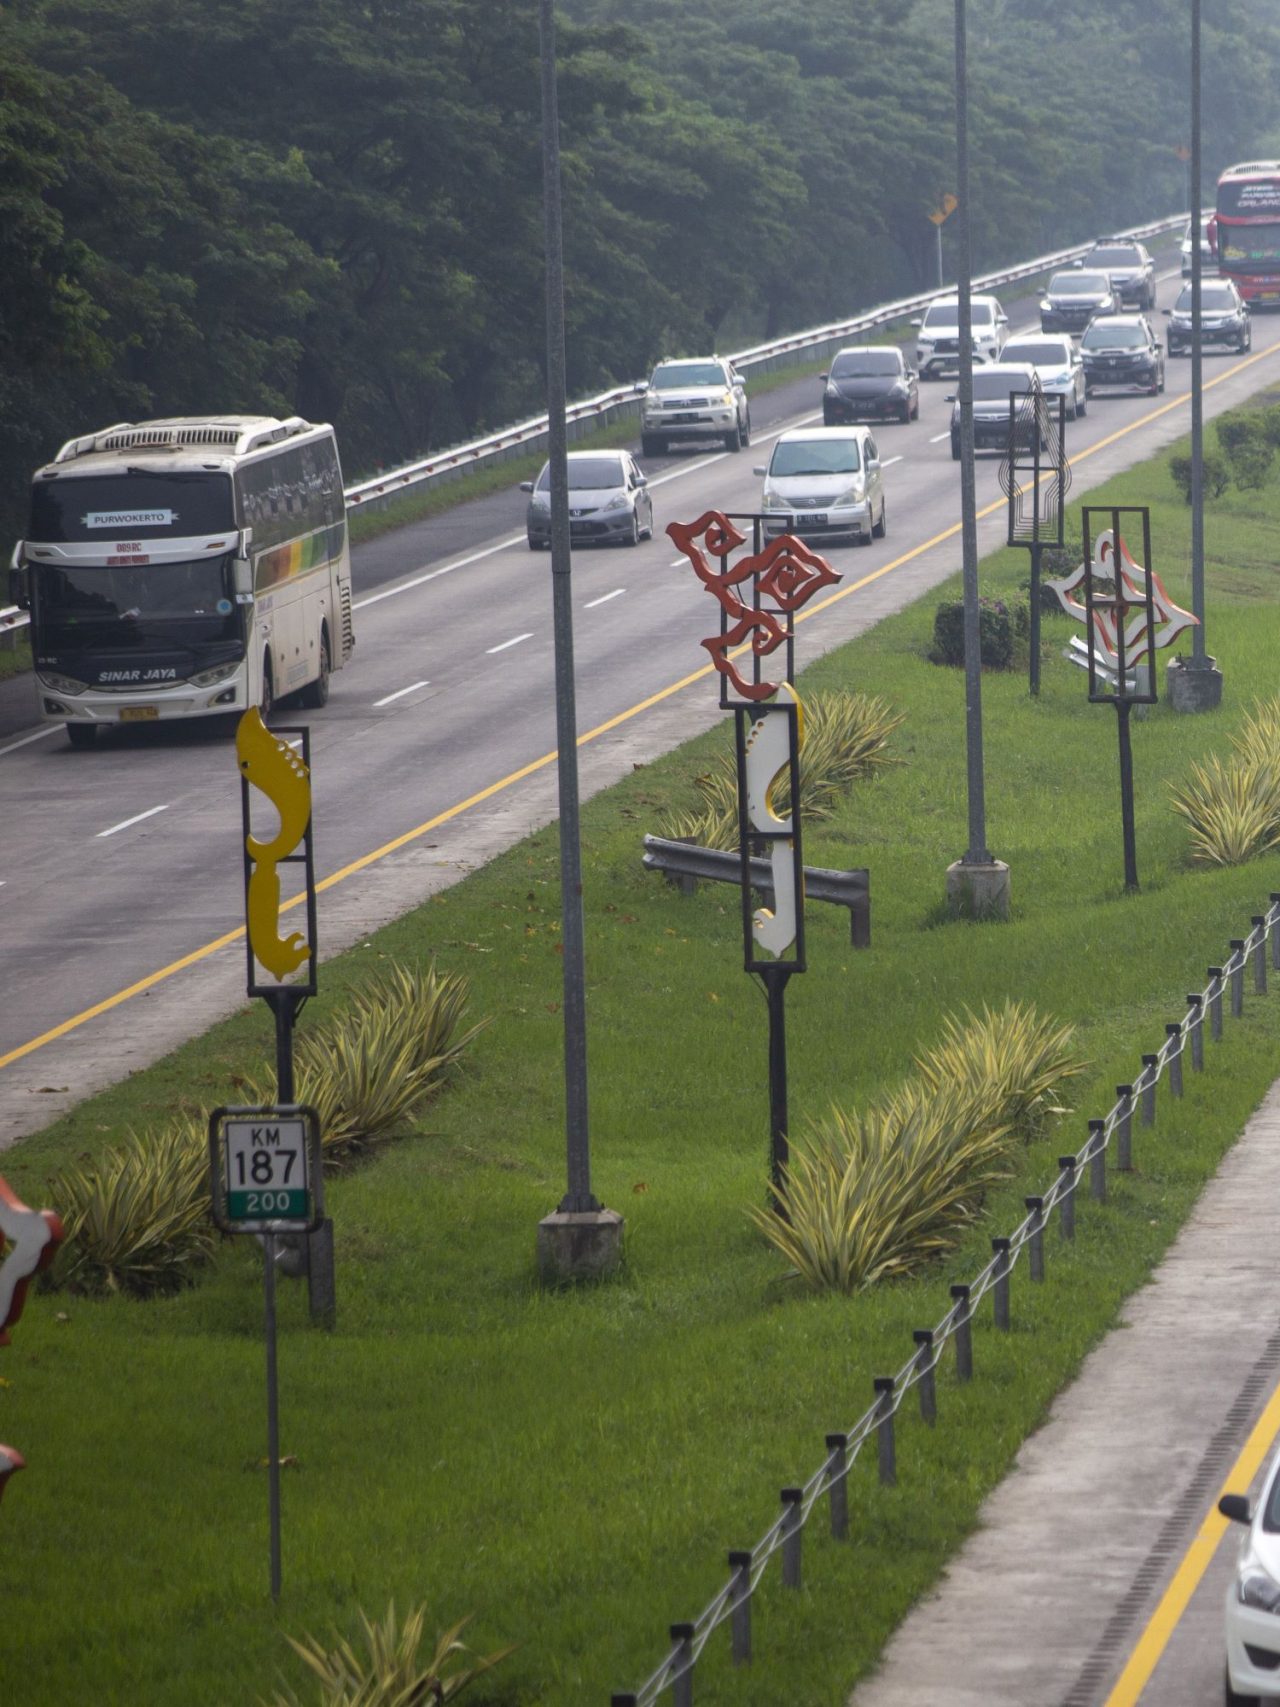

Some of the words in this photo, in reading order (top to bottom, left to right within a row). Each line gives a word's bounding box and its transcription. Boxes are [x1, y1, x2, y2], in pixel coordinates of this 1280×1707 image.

[94, 513, 165, 524] PURWOKERTO
[98, 670, 141, 682] SINAR
[143, 668, 177, 679] JAYA
[251, 1127, 280, 1147] KM
[235, 1150, 297, 1185] 187
[247, 1192, 290, 1212] 200
